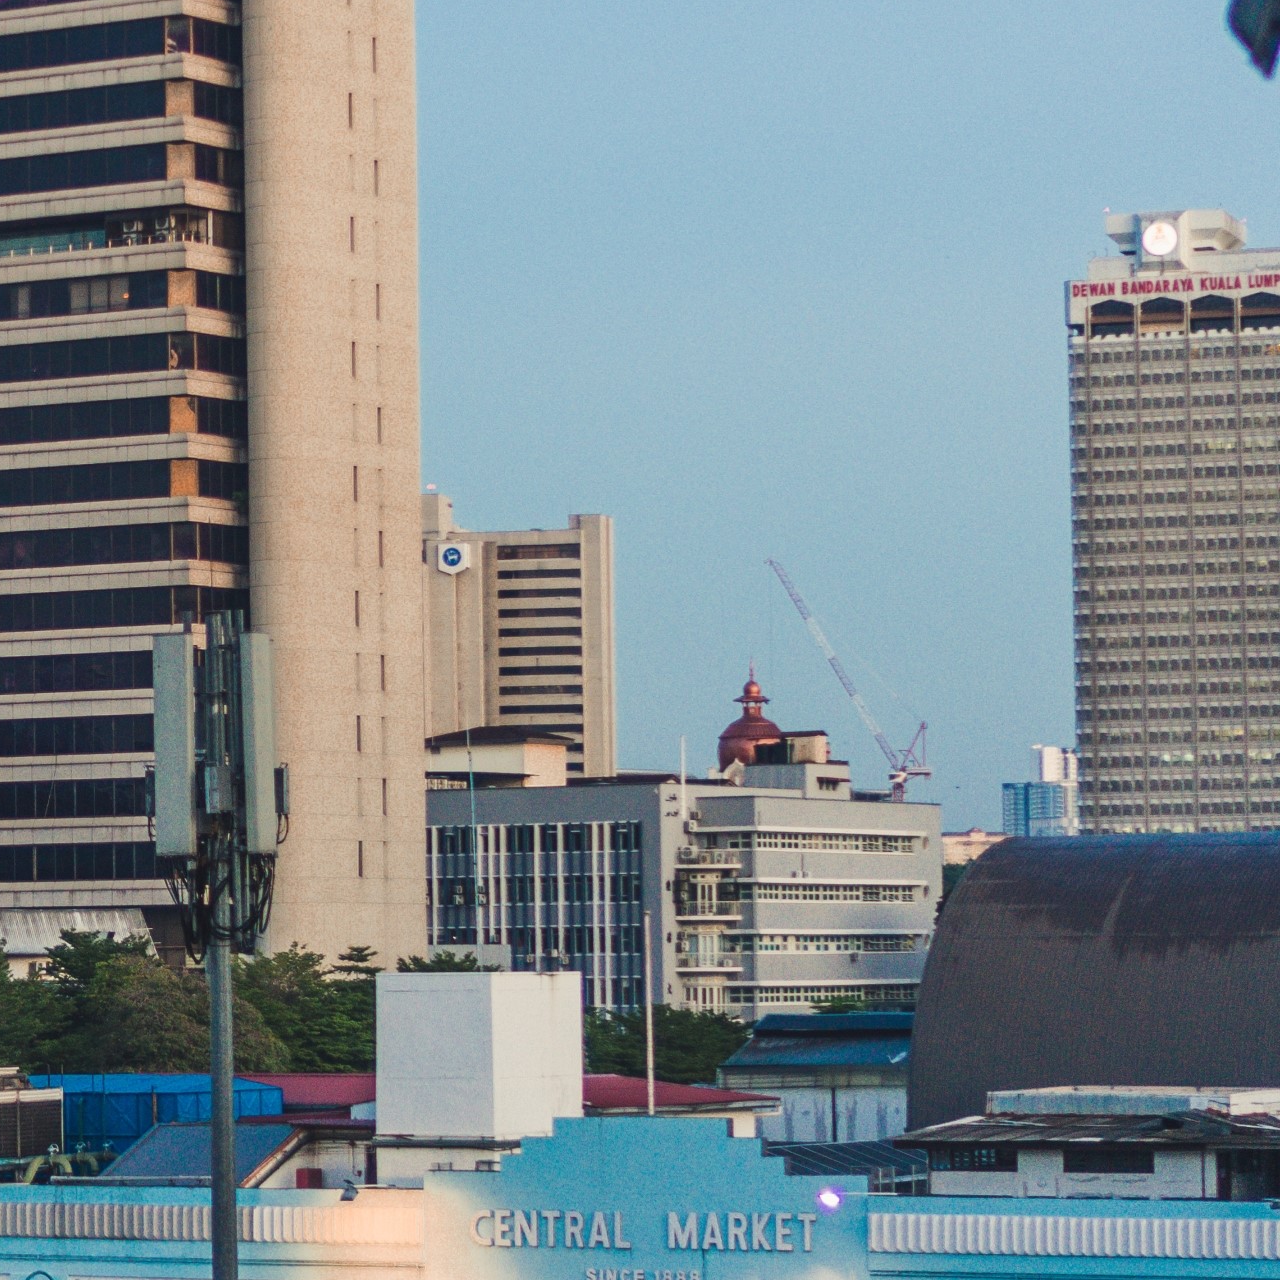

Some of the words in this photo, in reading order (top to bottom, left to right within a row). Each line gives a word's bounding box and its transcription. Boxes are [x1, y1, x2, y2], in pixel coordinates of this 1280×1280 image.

[1072, 282, 1115, 298] DEWAN
[1121, 278, 1194, 296] BANDARAYA
[1200, 275, 1242, 292] KUALA
[471, 1208, 632, 1250] CENTRAL
[667, 1211, 818, 1252] MARKET
